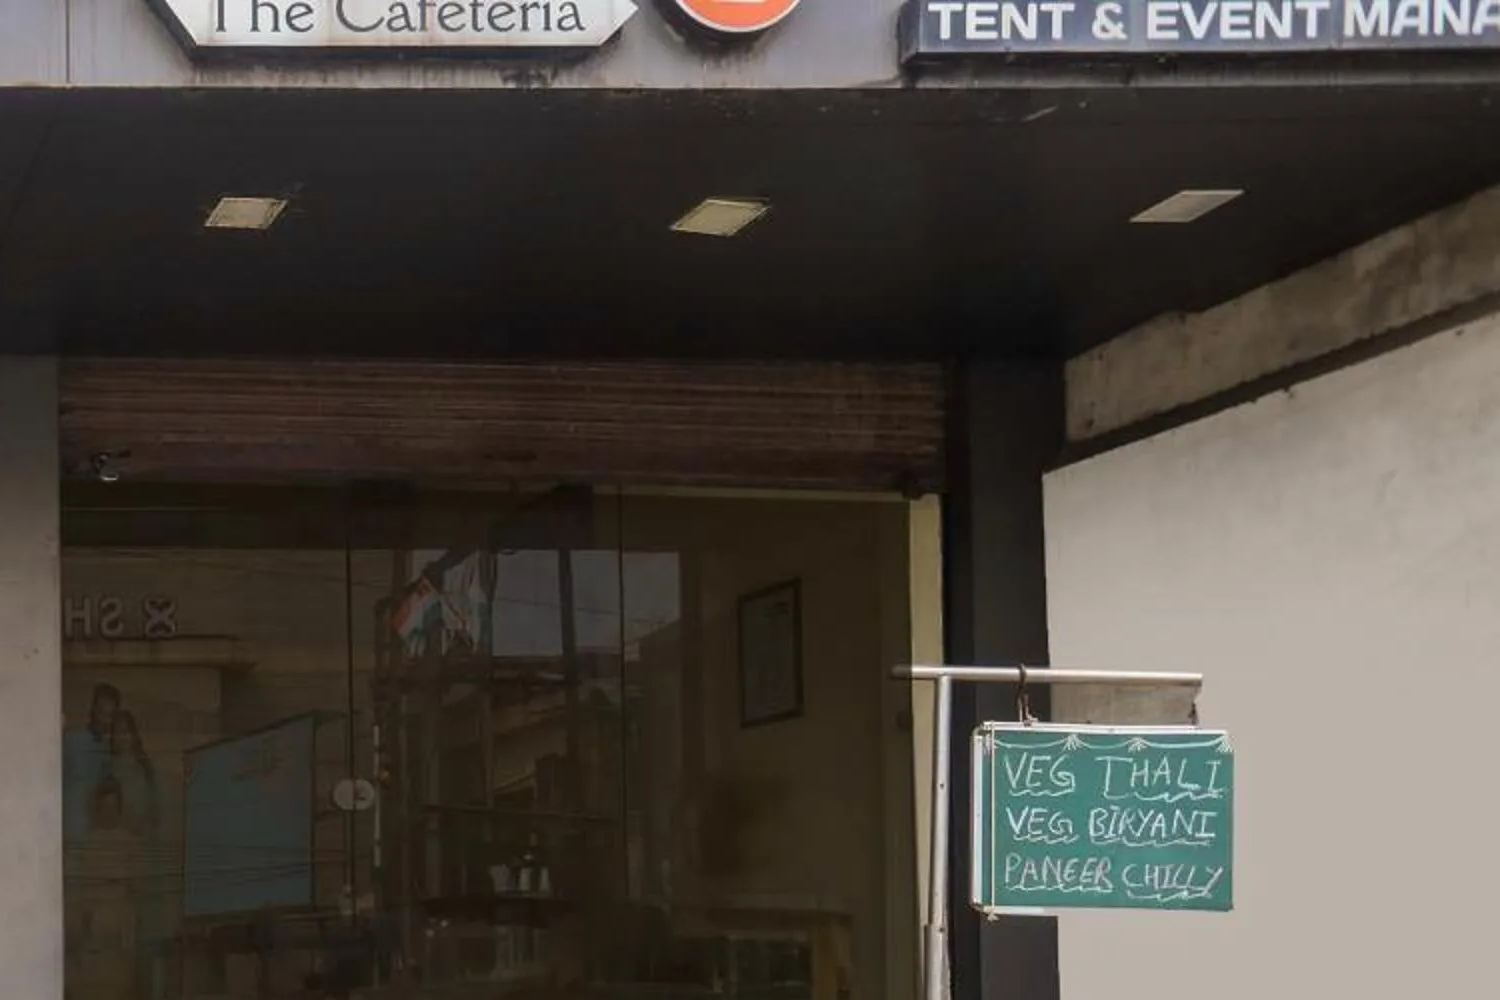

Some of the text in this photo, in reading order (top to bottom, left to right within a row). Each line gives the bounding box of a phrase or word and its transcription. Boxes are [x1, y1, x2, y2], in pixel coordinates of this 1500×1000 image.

[213, 0, 587, 33] The Cafeteria
[927, 2, 1075, 40] TENT
[1091, 2, 1129, 40] &
[1146, 1, 1331, 40] EVENT
[1003, 751, 1224, 797] VEG THALI
[1005, 804, 1218, 838] VEG BIRYANI
[1004, 852, 1224, 891] PANEER CHILLY
